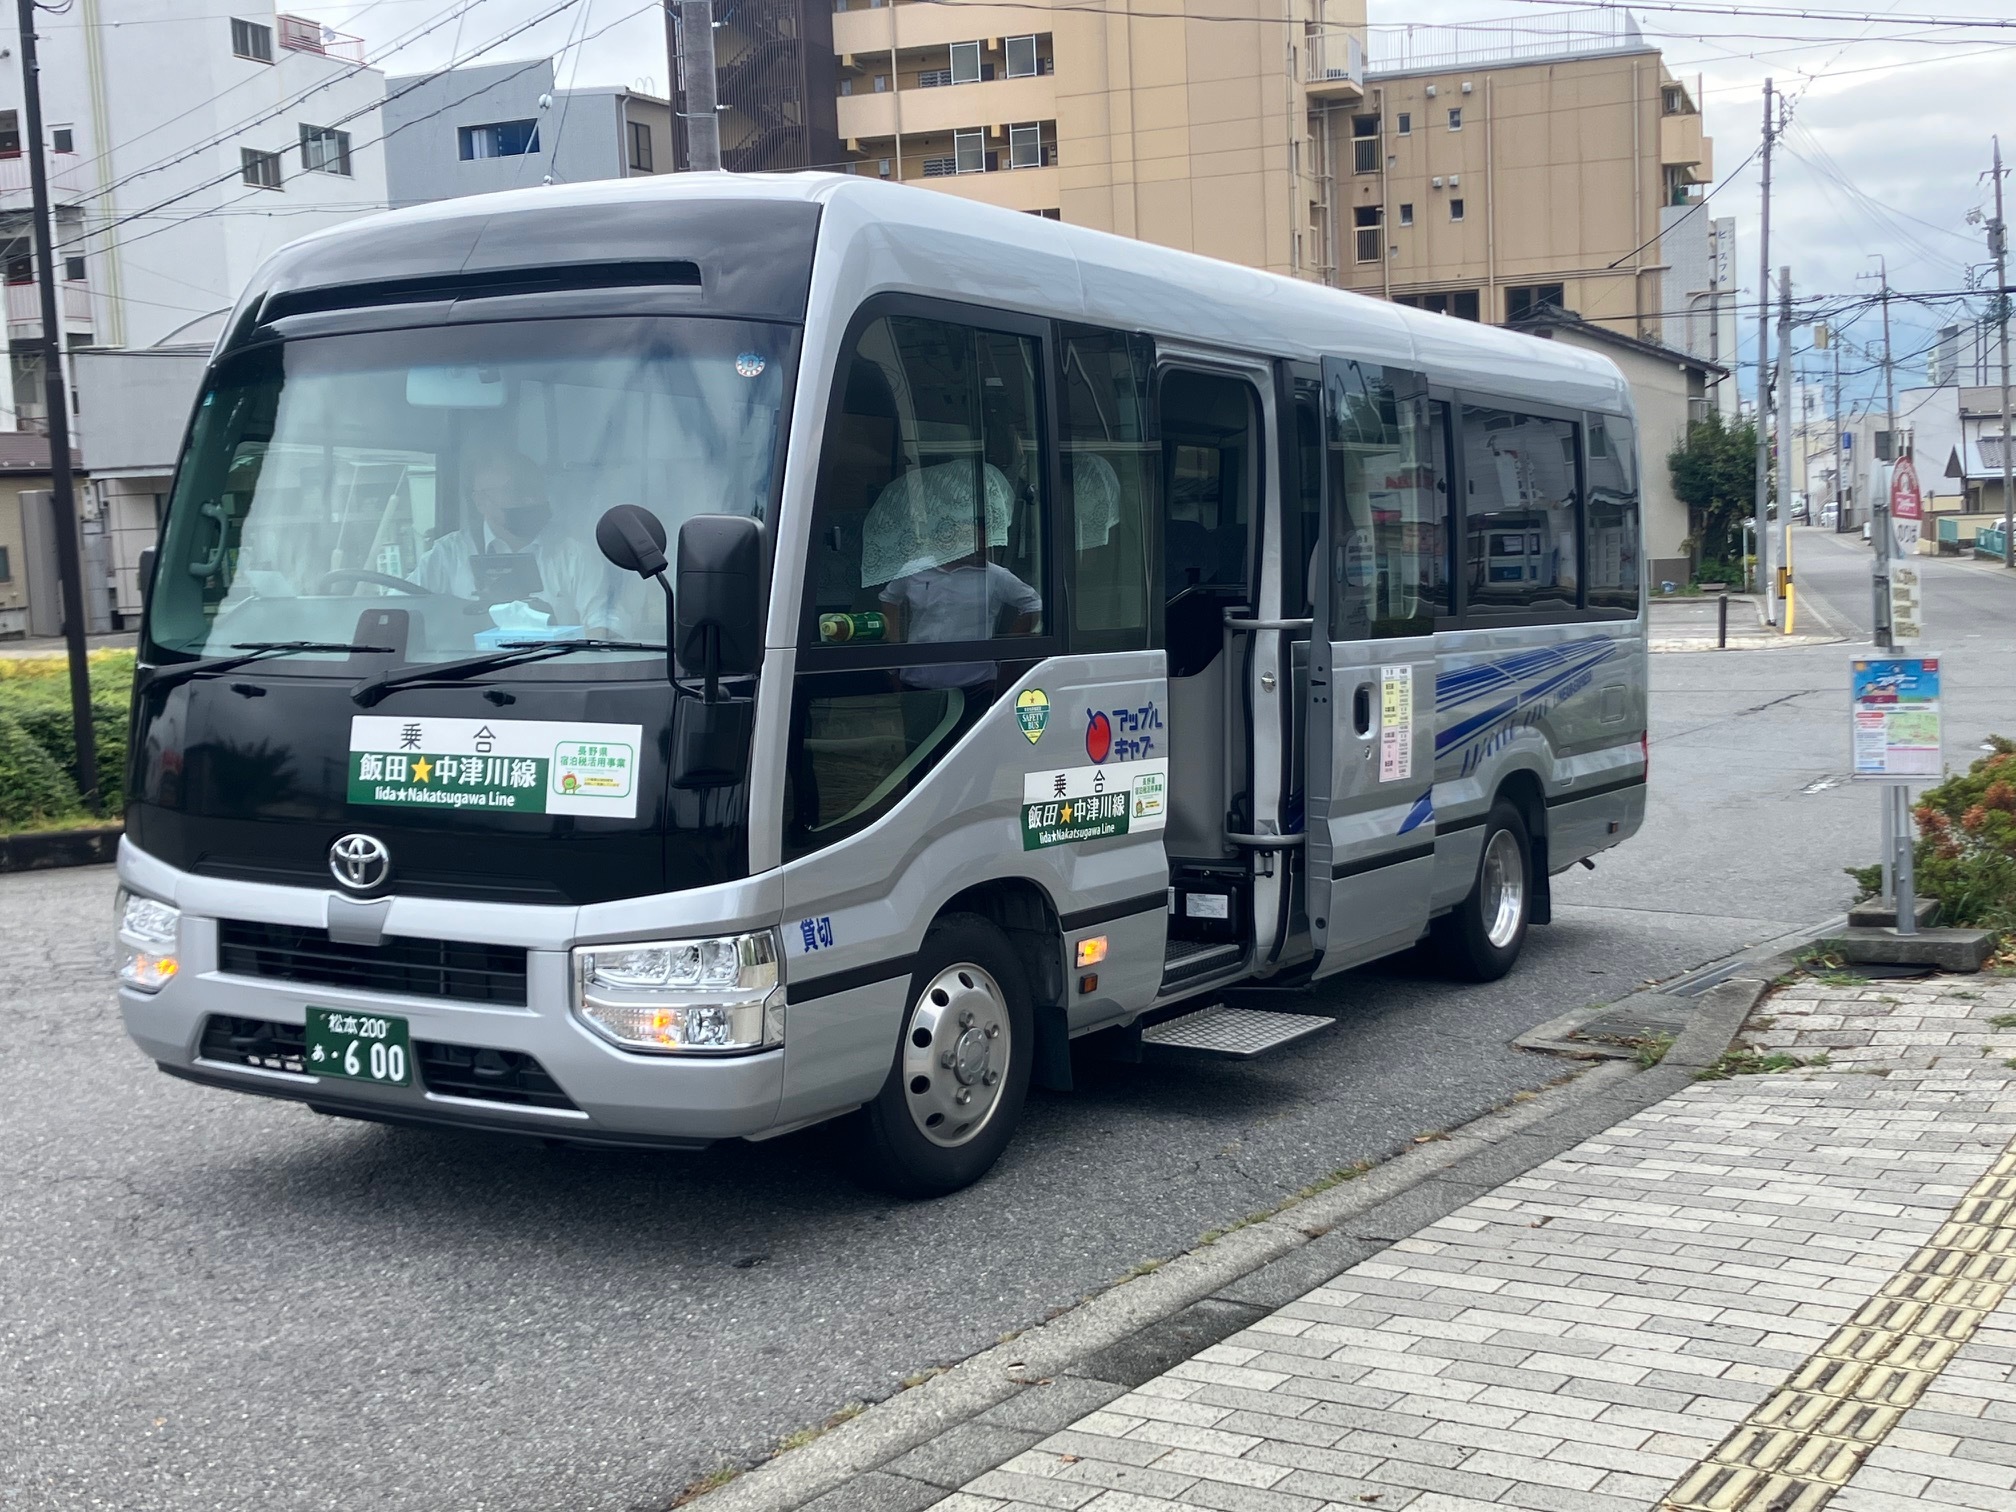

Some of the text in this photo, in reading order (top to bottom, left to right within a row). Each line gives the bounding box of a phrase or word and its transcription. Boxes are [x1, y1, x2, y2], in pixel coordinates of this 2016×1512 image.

[1022, 712, 1043, 723] SAFETY
[1112, 701, 1163, 732] アップル
[1027, 721, 1040, 730] BUS
[578, 745, 608, 757] 長野県
[1114, 736, 1154, 762] キャブ
[560, 756, 626, 768] 宿泊税活用事業
[488, 791, 515, 807] Line
[1101, 822, 1115, 834] Line
[800, 916, 834, 953] 貸切
